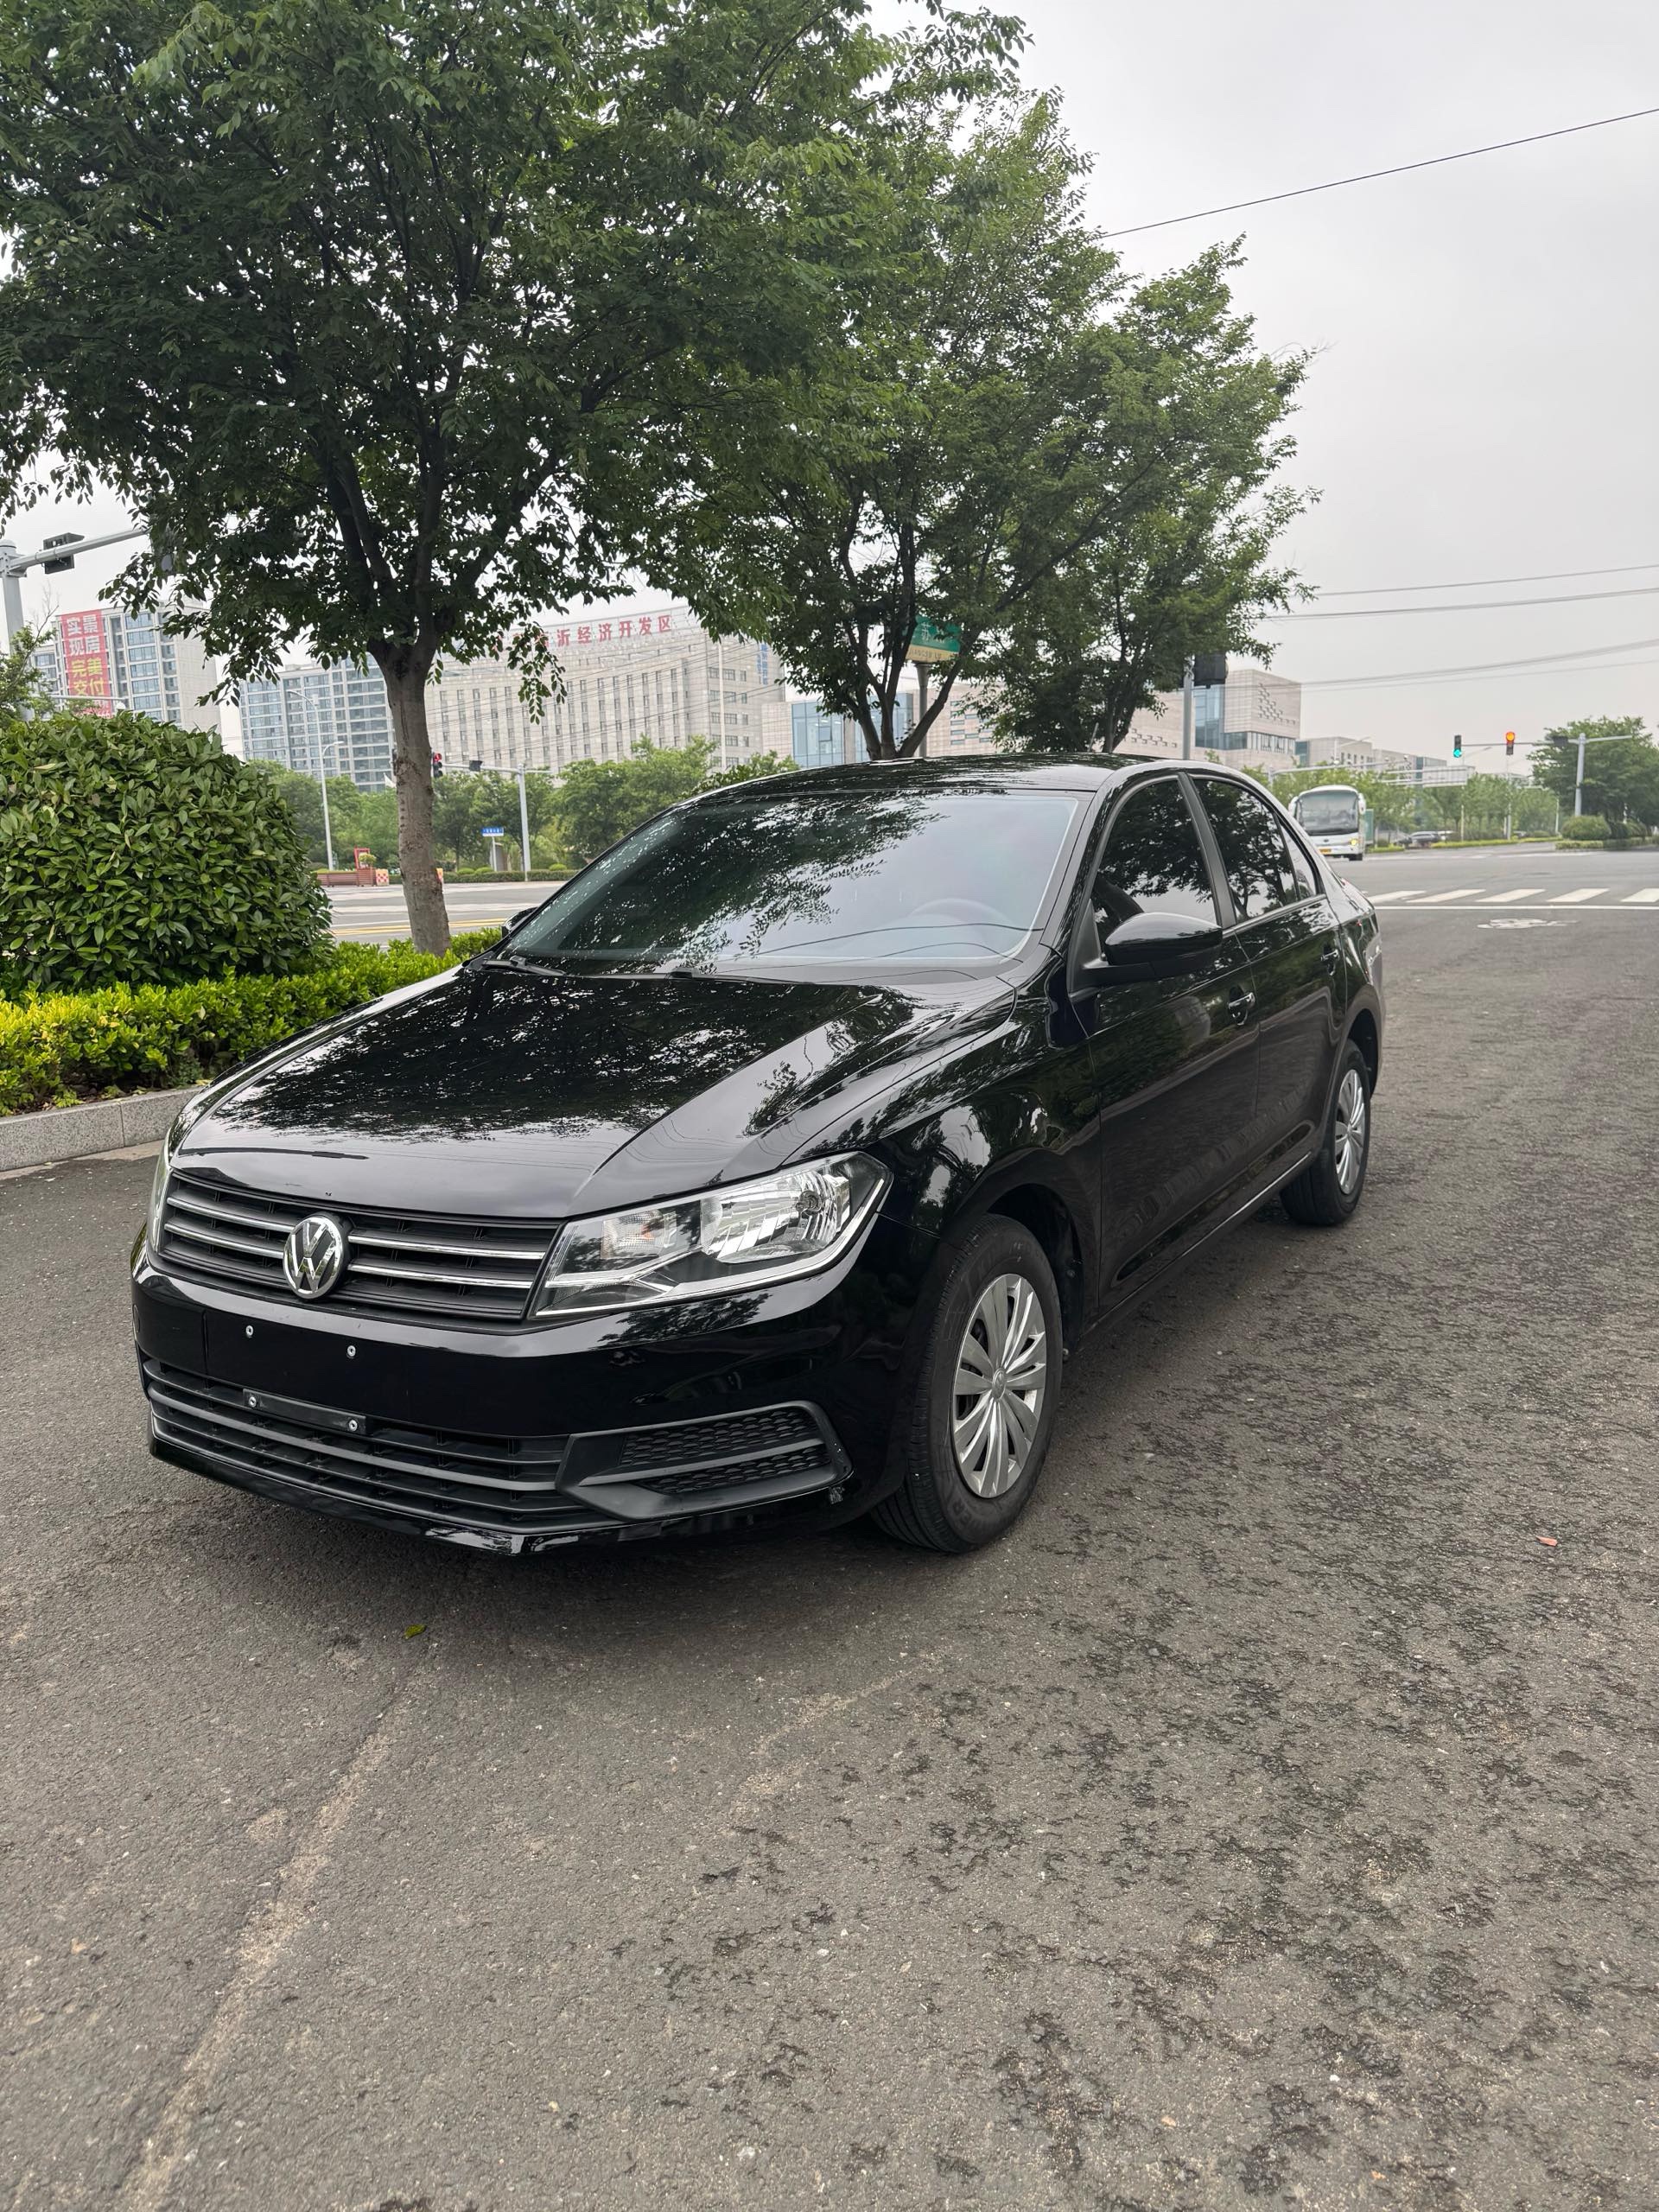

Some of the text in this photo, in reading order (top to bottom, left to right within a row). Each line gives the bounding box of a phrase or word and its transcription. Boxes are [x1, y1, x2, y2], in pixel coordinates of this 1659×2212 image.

[67, 614, 98, 636] 实景
[492, 614, 671, 650] 沂经济开发区
[73, 677, 105, 696] 交付
